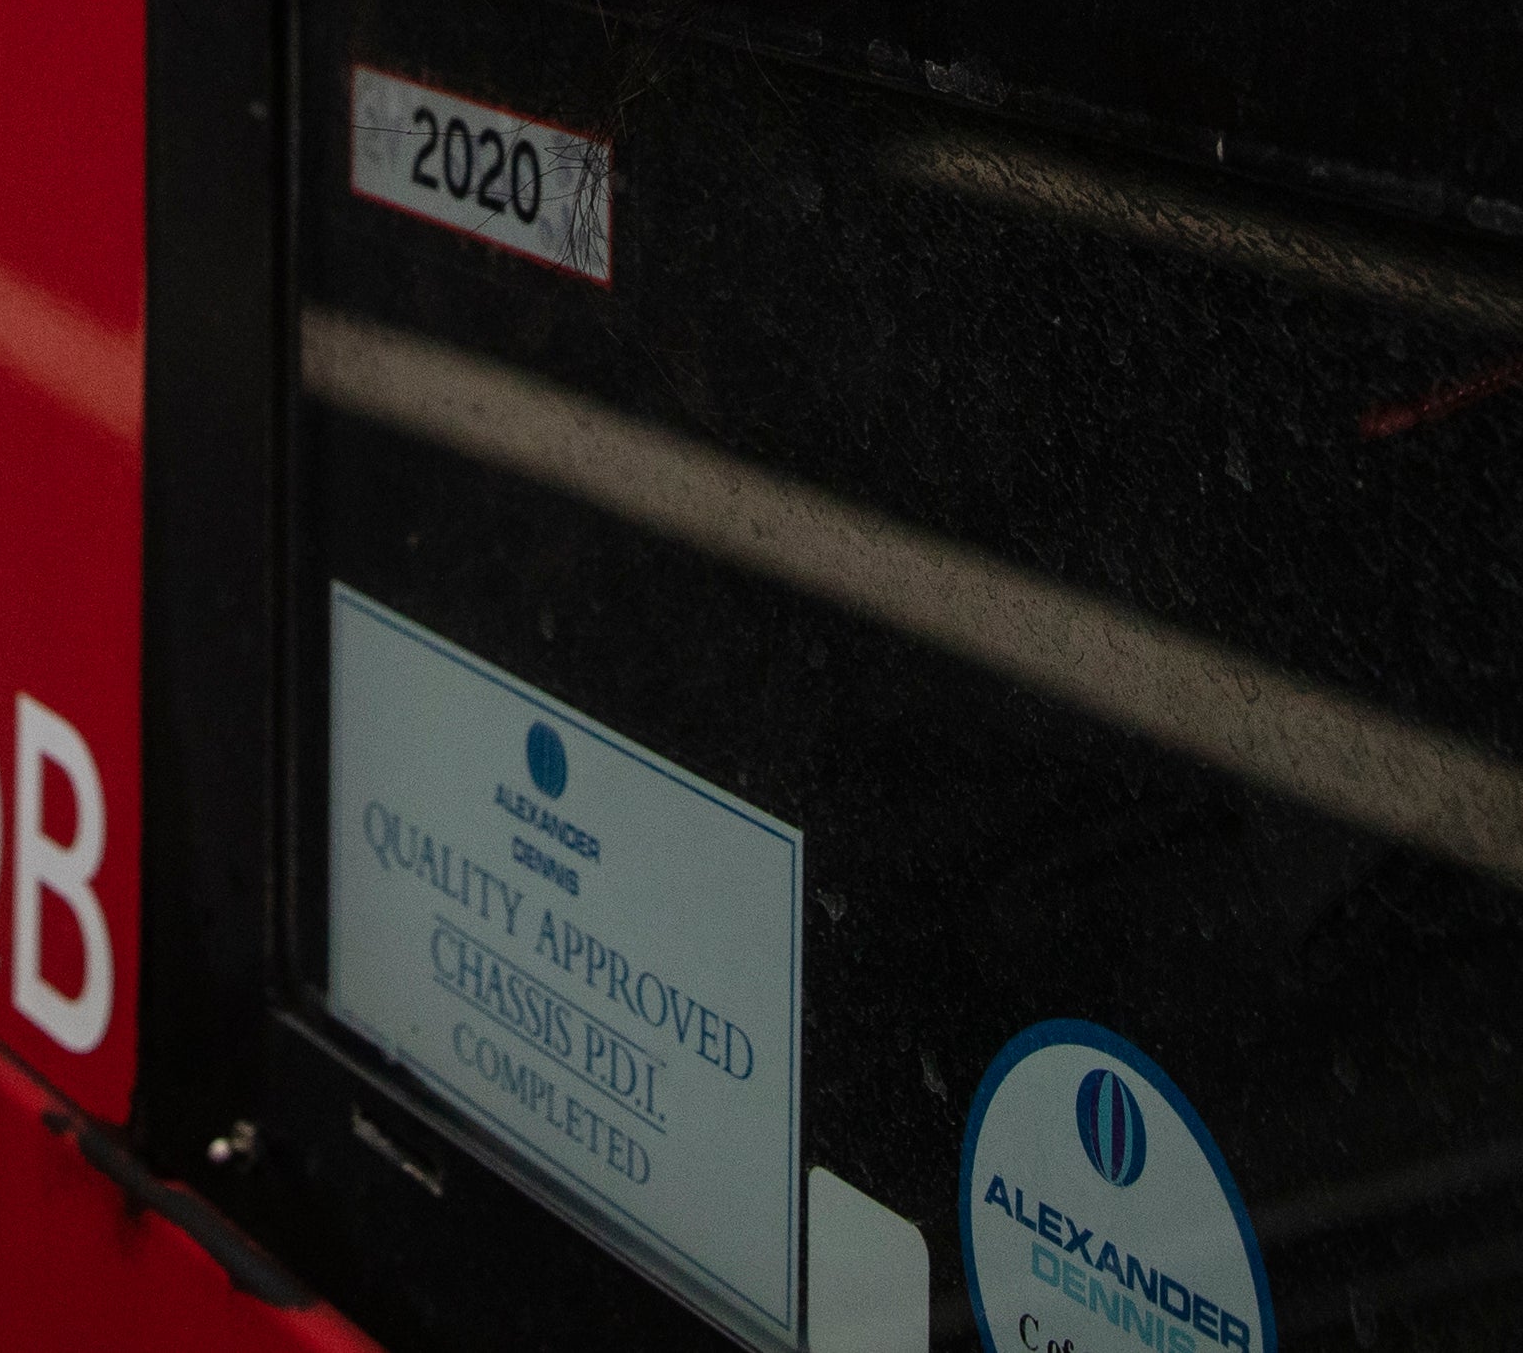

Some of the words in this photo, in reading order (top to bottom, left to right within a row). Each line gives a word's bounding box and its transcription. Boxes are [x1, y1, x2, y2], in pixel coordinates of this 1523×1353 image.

[411, 107, 542, 224] 2020
[495, 784, 601, 863] ALEXANDER
[512, 836, 580, 896] DENNIS
[363, 800, 523, 936] QUALITY
[535, 908, 754, 1081] APPROVED
[431, 925, 573, 1061] CHASSIS
[454, 1021, 651, 1186] COMPLETED
[984, 1174, 1250, 1353] ALEXANDER
